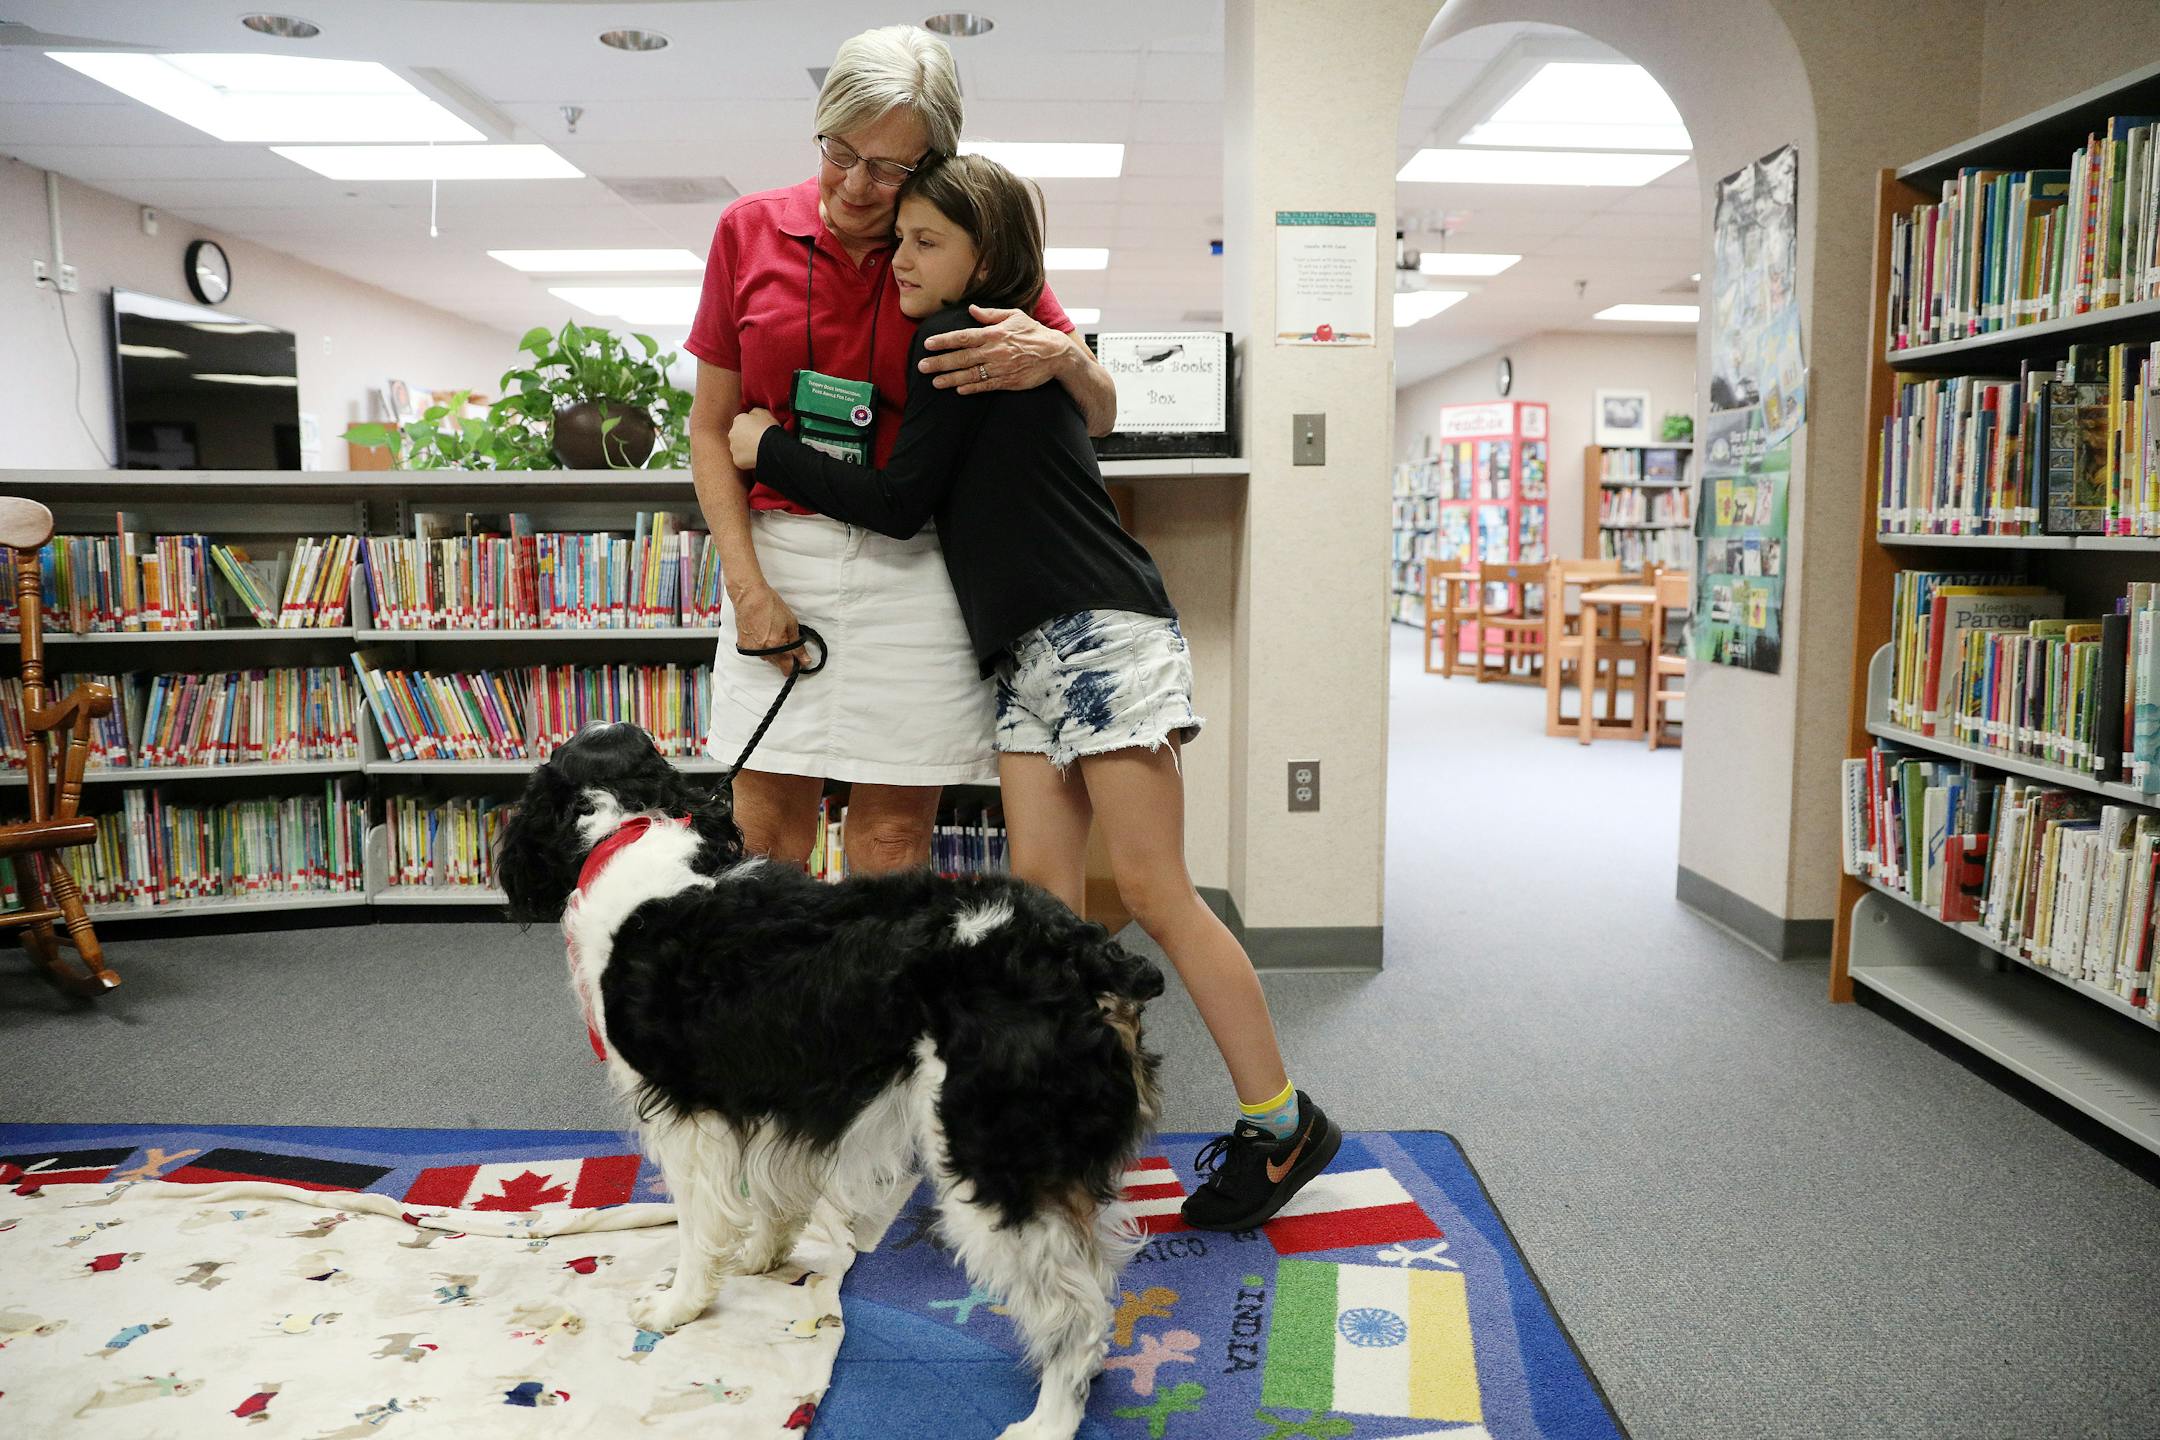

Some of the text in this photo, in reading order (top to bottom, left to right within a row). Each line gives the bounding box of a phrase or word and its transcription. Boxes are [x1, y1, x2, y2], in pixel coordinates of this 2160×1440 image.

[1110, 358, 1144, 373] Back
[1171, 356, 1213, 373] Books
[1147, 390, 1176, 405] Box
[1926, 573, 2026, 587] MADELINE
[1974, 602, 2032, 613] Meet the
[1223, 1289, 1265, 1375] INDIA
